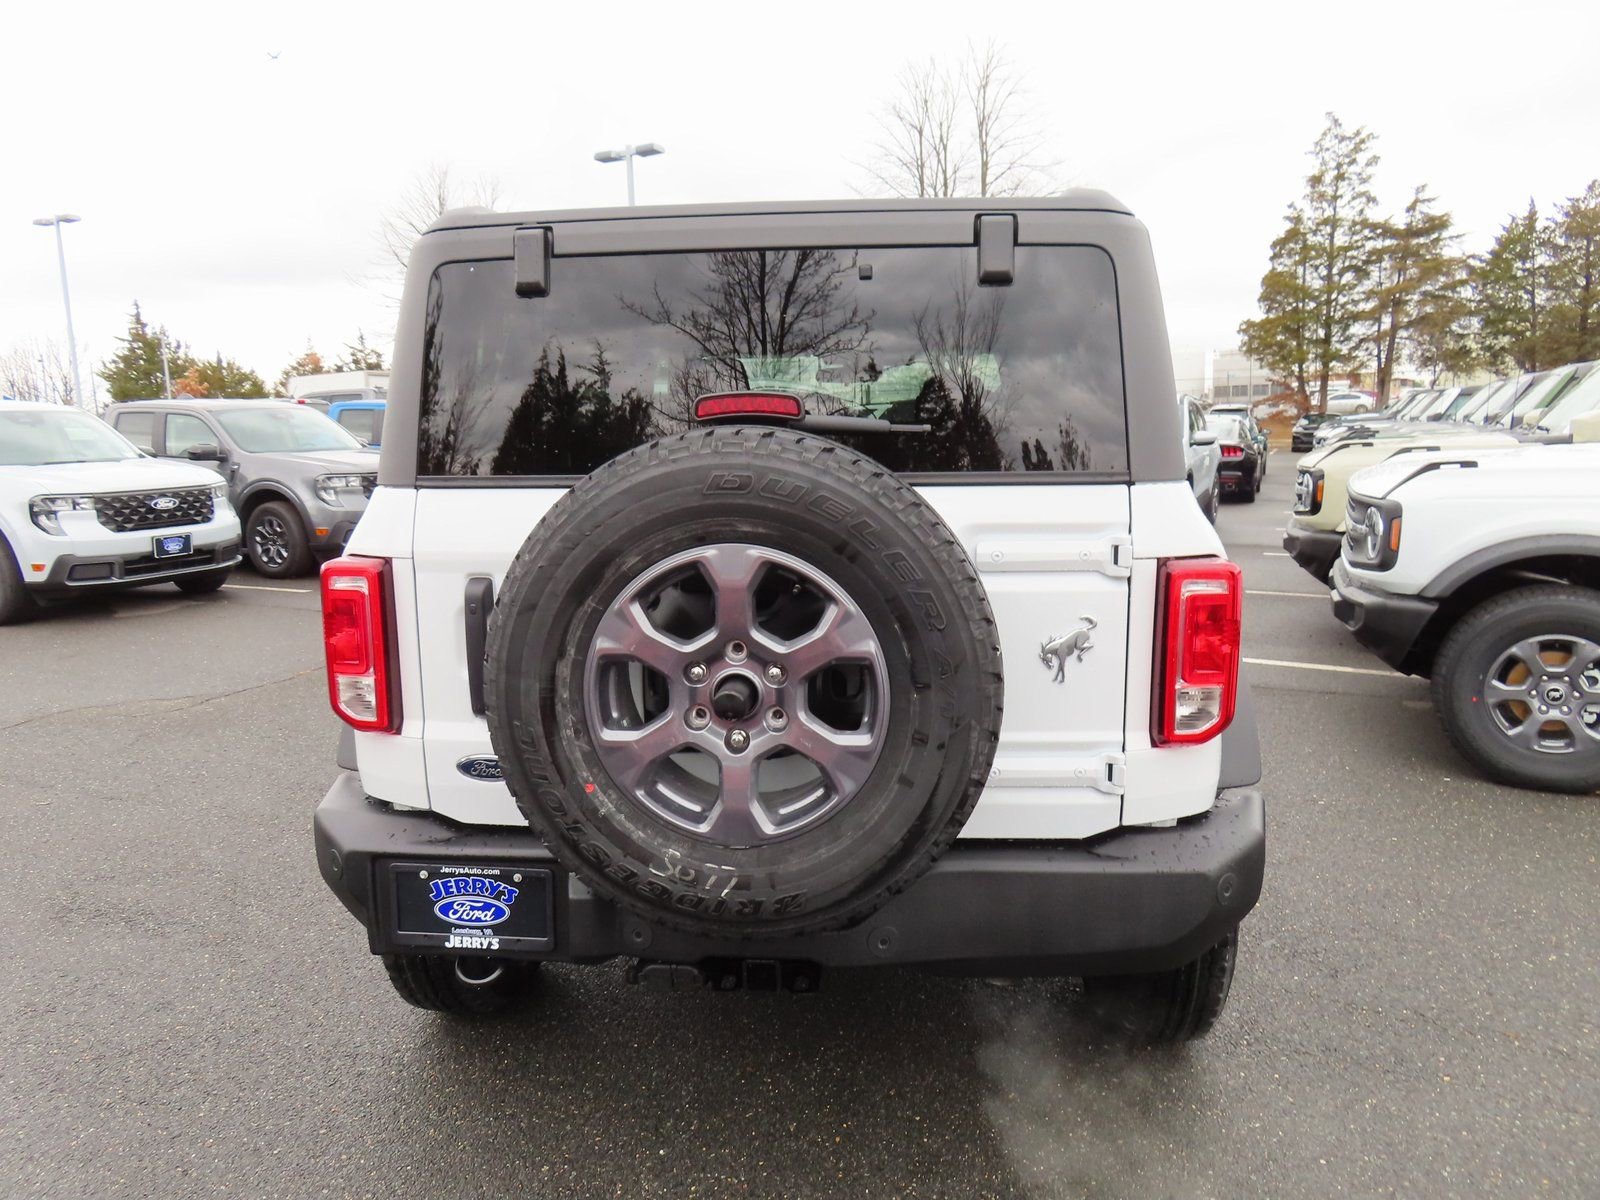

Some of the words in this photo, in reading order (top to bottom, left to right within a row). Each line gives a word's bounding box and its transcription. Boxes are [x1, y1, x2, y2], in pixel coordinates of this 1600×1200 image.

[703, 471, 947, 631] DUELER
[515, 722, 808, 915] BRIDGESTONE
[440, 866, 500, 875] JerrysAuto.com
[429, 876, 519, 904] JERRY'S
[448, 900, 496, 921] Ford
[444, 934, 500, 950] JERRY'S
